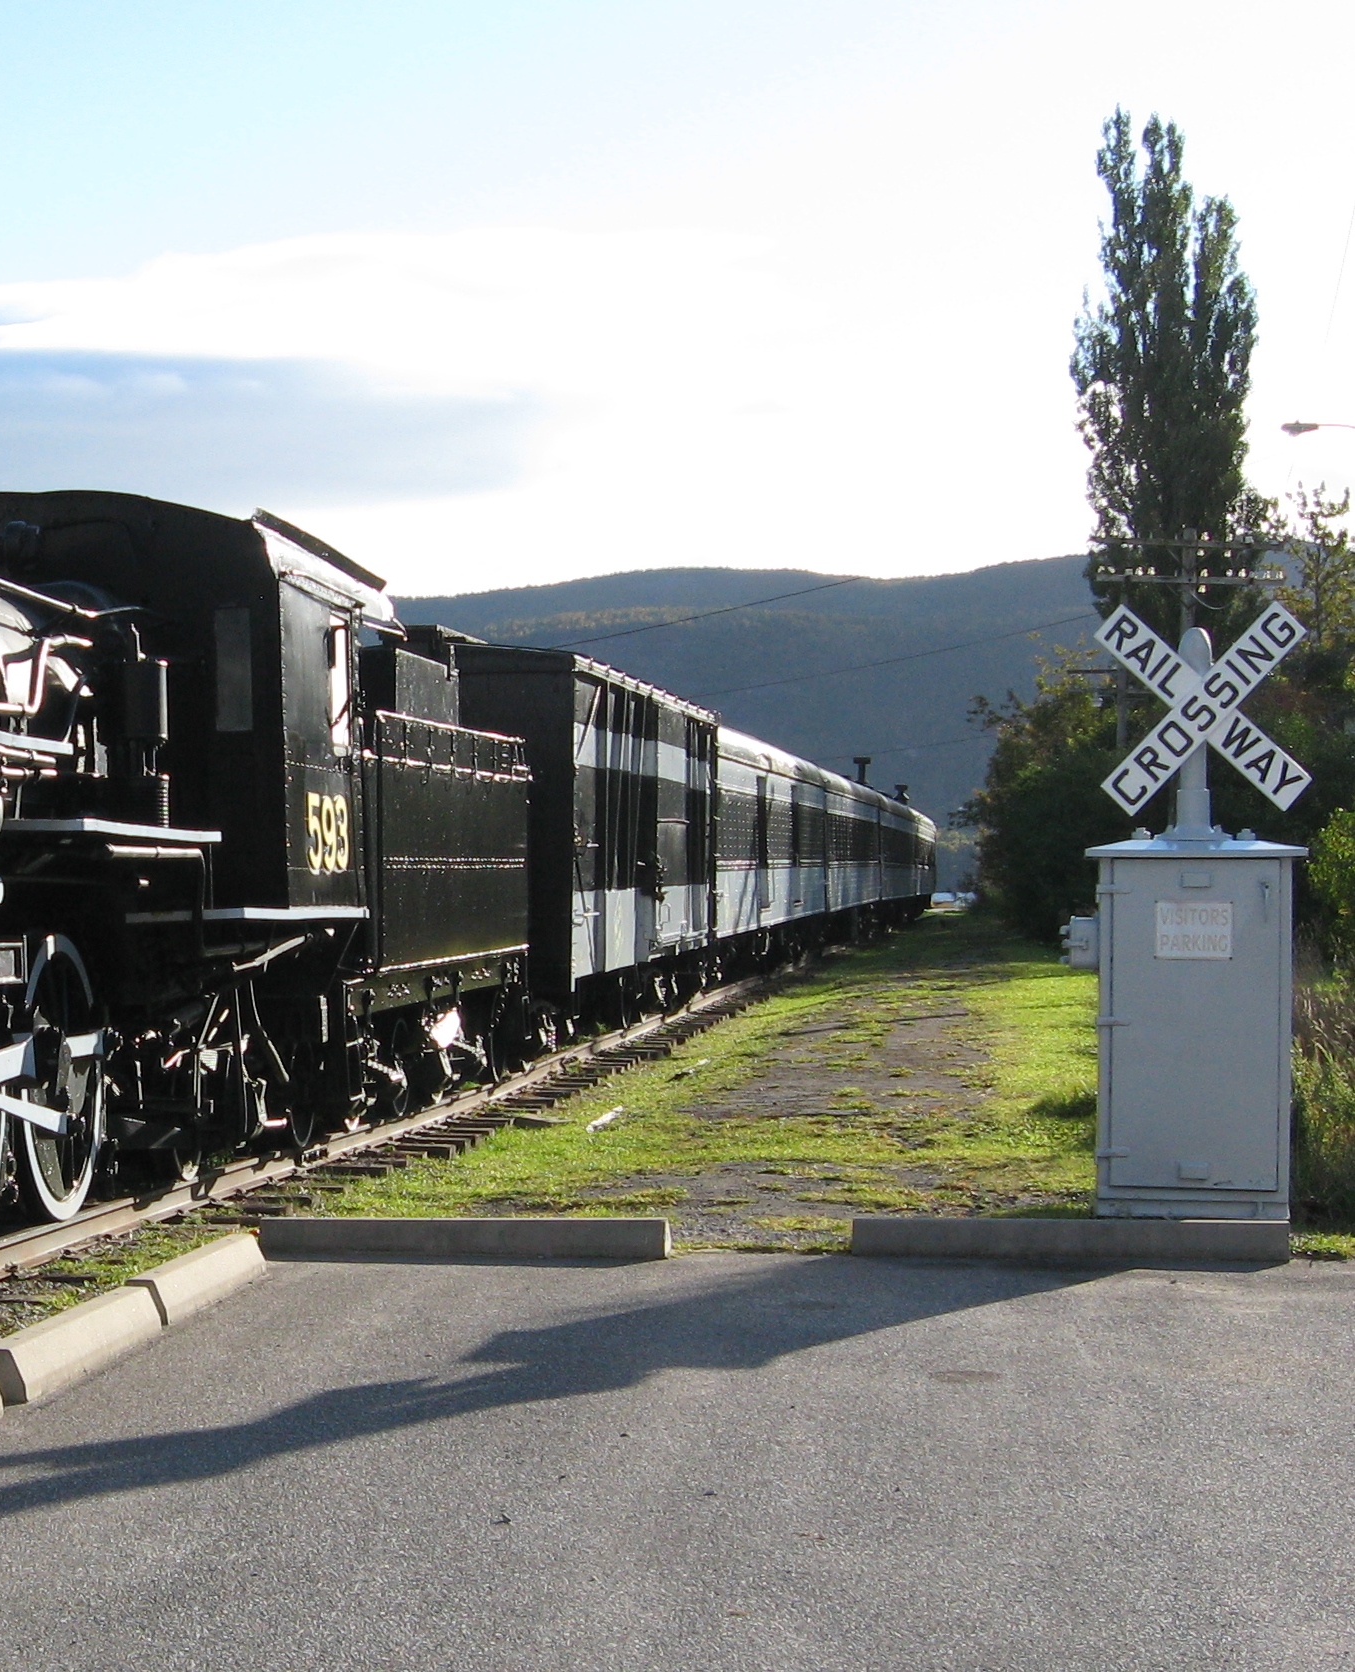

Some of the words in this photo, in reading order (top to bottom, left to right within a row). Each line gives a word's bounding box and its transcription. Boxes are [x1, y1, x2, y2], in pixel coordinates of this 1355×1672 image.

[1103, 613, 1183, 699] RAIL
[1221, 716, 1304, 796] WAY
[1111, 611, 1297, 806] CROSSING
[305, 791, 350, 875] 593
[1159, 908, 1228, 926] VISITORS
[1159, 934, 1228, 951] PARKING
